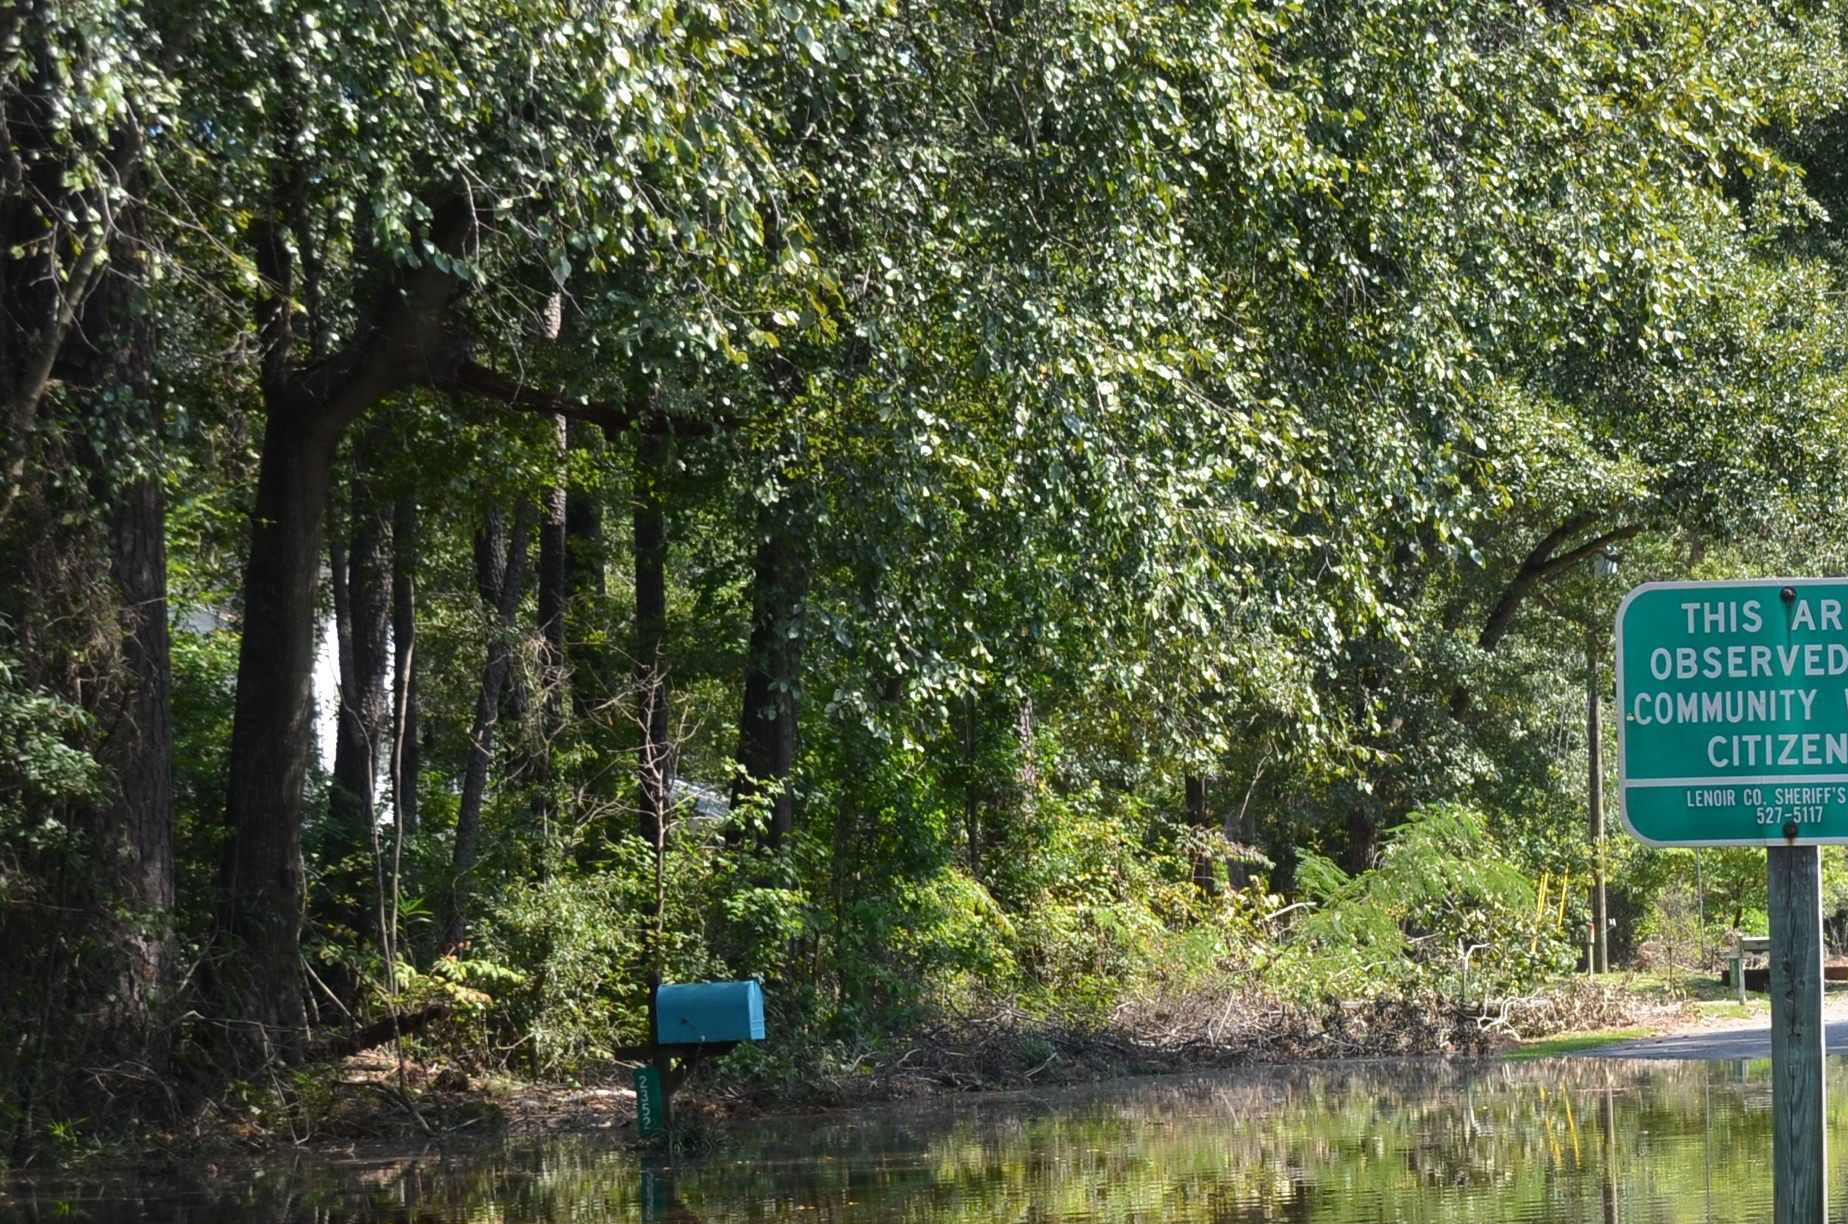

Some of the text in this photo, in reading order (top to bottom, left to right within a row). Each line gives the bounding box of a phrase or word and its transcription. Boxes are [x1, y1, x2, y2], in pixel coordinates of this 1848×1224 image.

[1681, 600, 1763, 634] THIS
[1650, 643, 1848, 681] OBSERVED
[1634, 688, 1818, 726] COMMUNITY
[1686, 789, 1736, 807] LENOIR
[1743, 788, 1767, 806] CO.
[1775, 786, 1846, 805] SHERIFF'S
[1756, 806, 1823, 825] 527-5117
[638, 1075, 651, 1130] 2352
